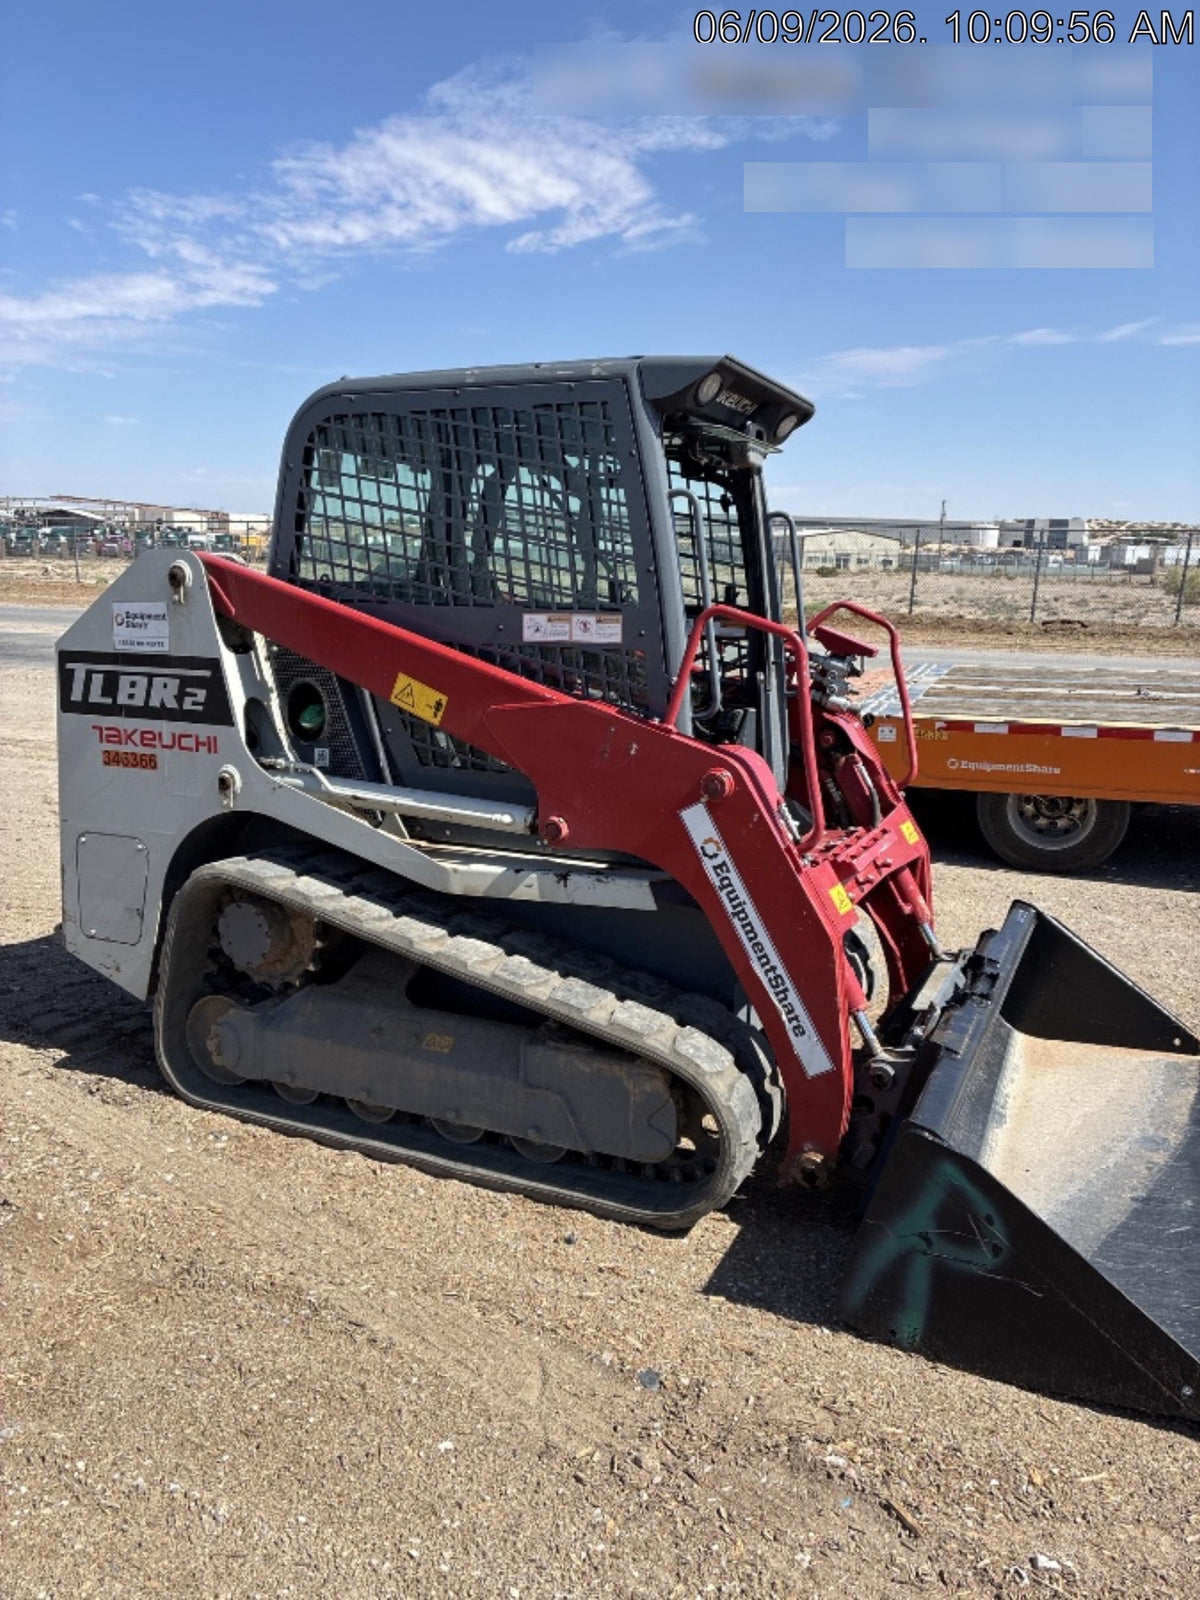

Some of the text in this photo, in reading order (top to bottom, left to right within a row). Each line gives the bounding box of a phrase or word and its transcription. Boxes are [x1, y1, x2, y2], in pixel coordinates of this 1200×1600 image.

[102, 750, 158, 770] 346366
[960, 760, 1061, 775] EquipmentShare
[711, 859, 807, 1039] EquipmentShare
